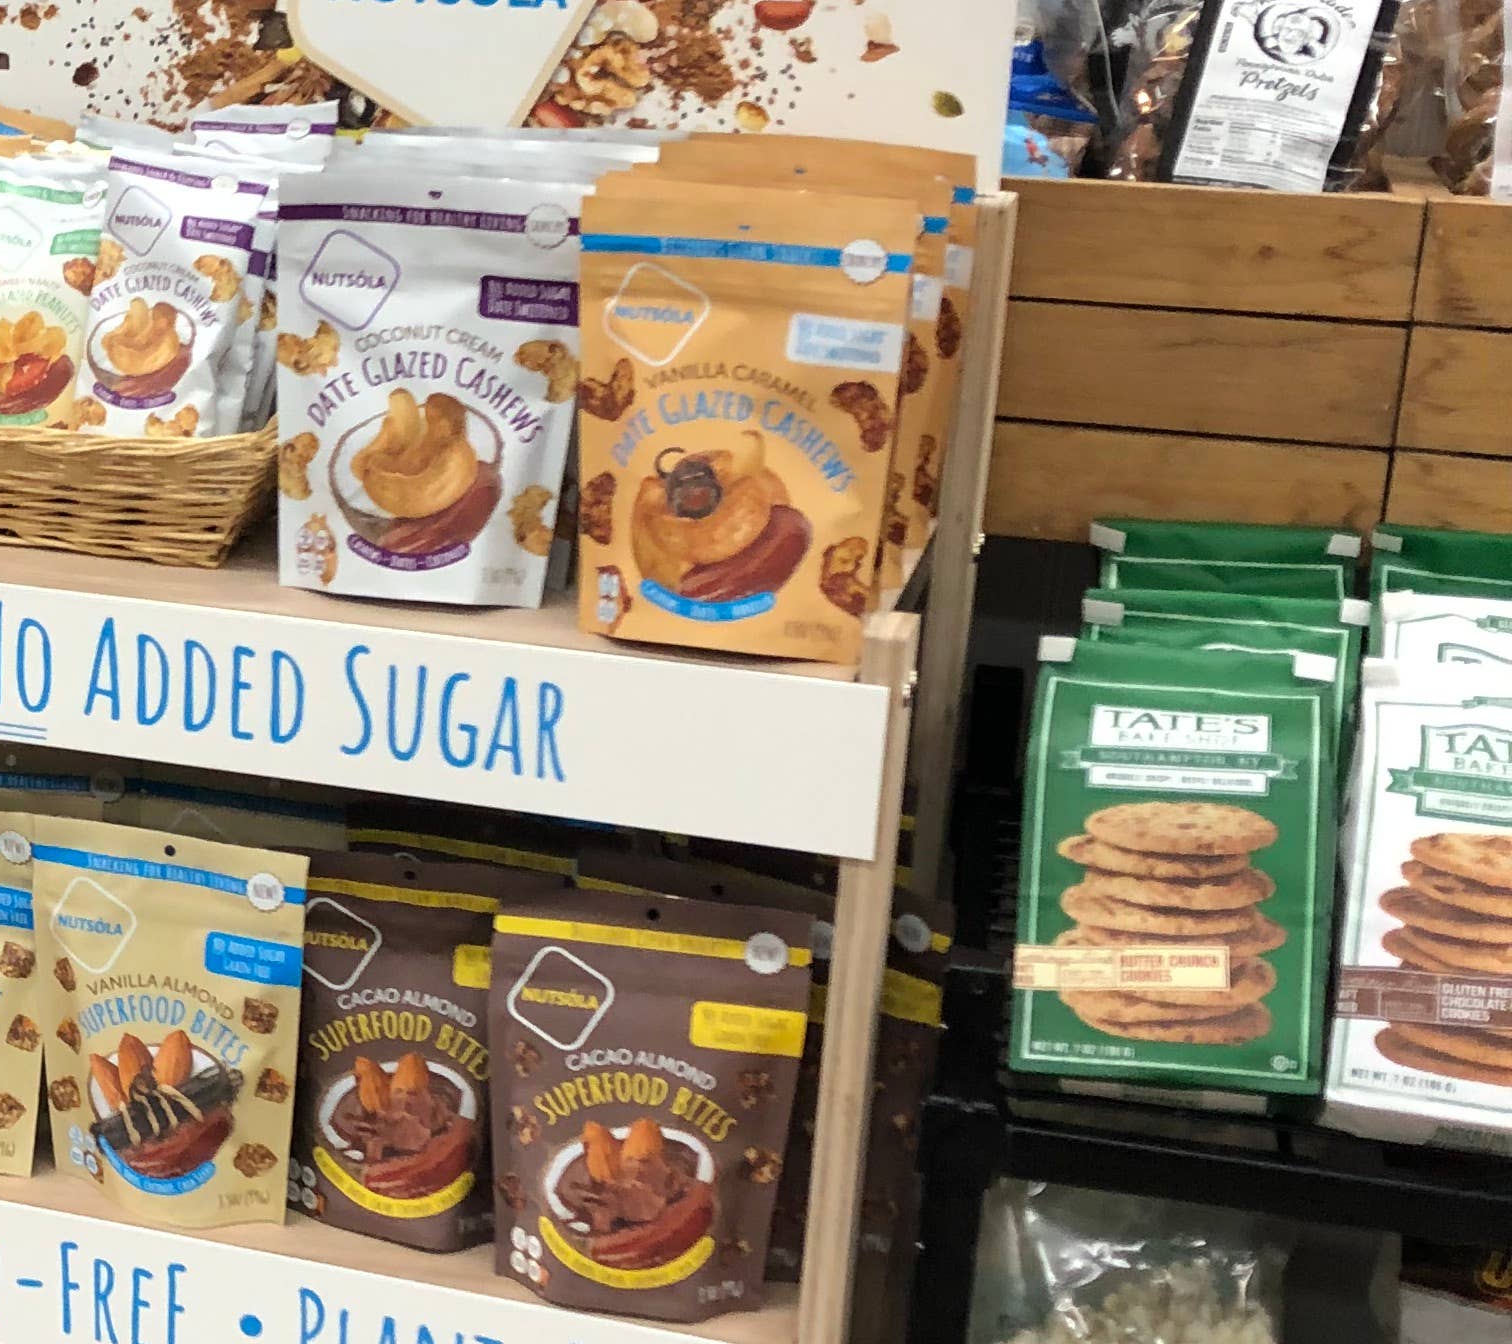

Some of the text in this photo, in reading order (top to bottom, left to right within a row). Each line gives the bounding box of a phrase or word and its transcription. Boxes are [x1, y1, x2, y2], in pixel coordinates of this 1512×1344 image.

[1238, 71, 1320, 102] Pretzels
[354, 324, 504, 364] COCONUT CREAM
[307, 351, 544, 444] DATE GLAZED CASHEWS
[84, 616, 306, 744] ADDED
[340, 644, 567, 783] SUGAR
[1103, 710, 1260, 735] TATE'S
[86, 972, 236, 1020] VANILLA ALMOND
[1441, 982, 1487, 998] GLUTEN
[78, 994, 249, 1064] SUPERFOOD BITES
[564, 1048, 717, 1091] CACAO ALMOND
[534, 1071, 738, 1143] SUPERFOOD BITES
